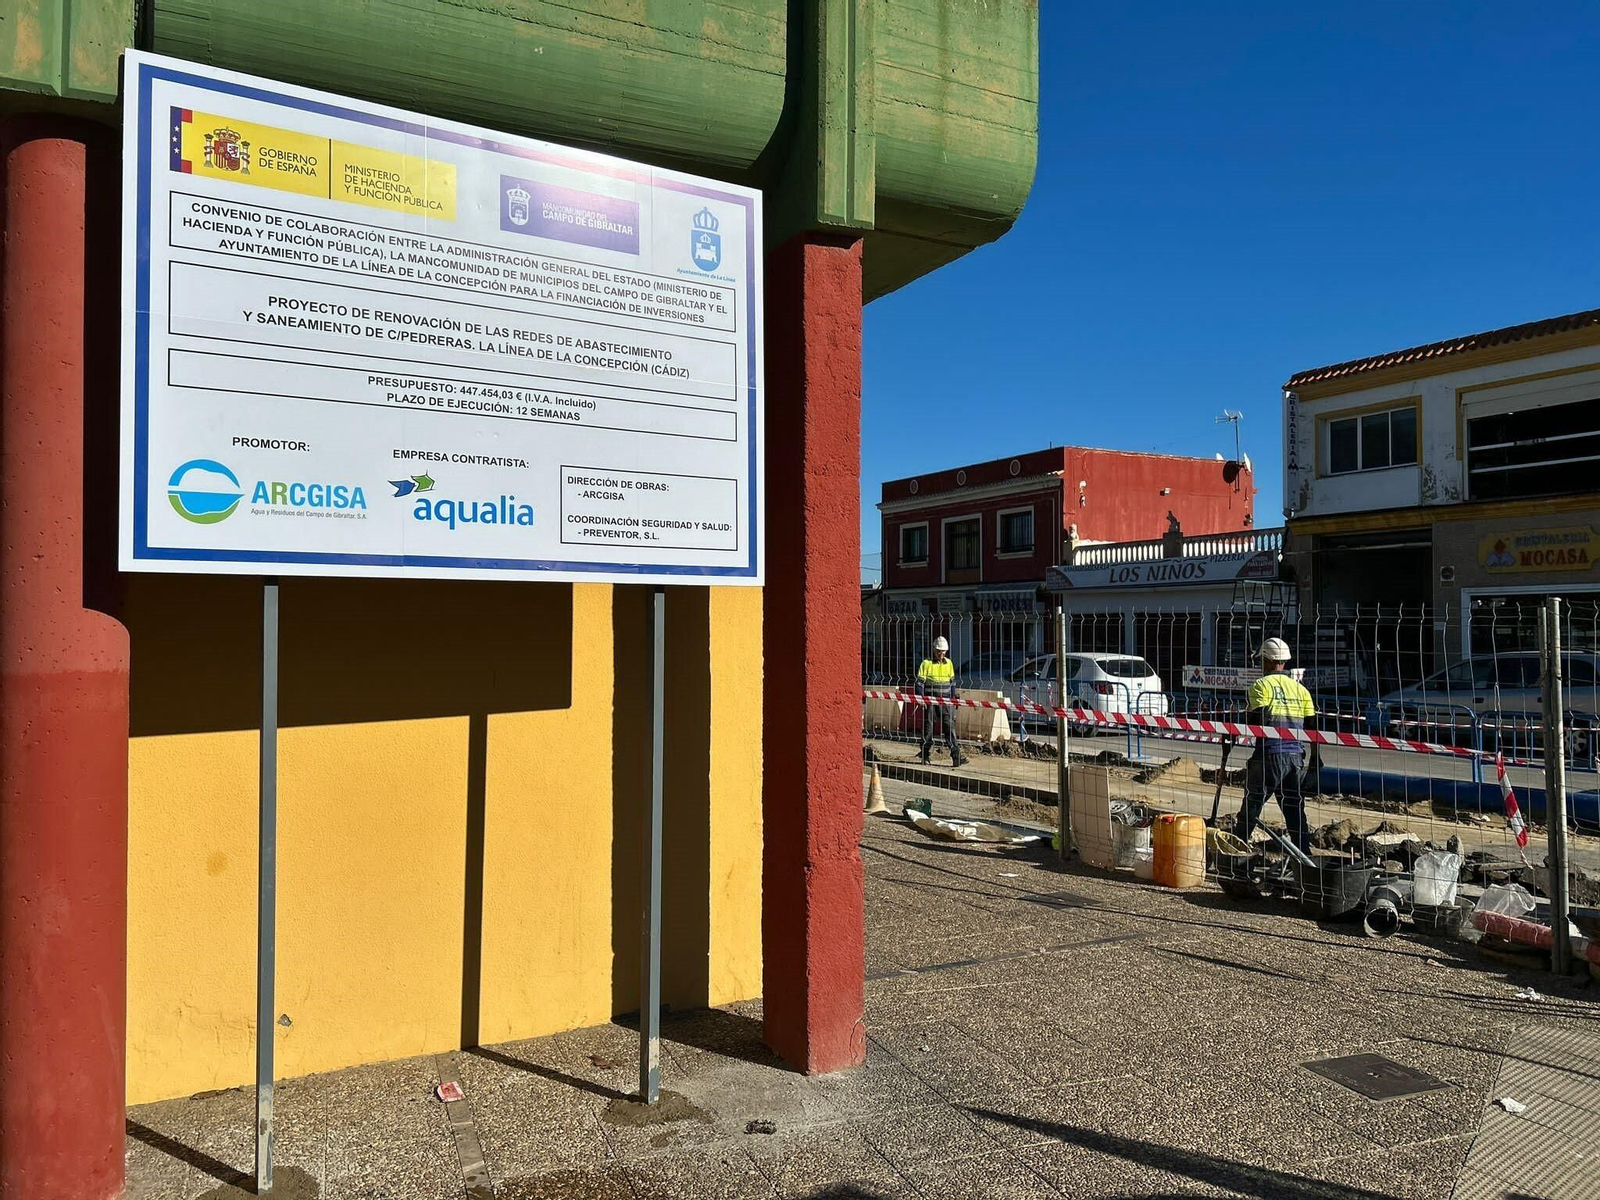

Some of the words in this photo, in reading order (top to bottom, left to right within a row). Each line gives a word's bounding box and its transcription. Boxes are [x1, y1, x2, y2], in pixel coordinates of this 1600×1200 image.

[258, 146, 317, 166] GOBIERNO
[258, 155, 274, 169] DE
[276, 158, 317, 177] ESPAÑA
[344, 163, 400, 182] MINISTERIO
[344, 173, 358, 185] DE
[360, 176, 412, 196] HACIENDA
[343, 182, 351, 194] Y
[354, 186, 401, 203] FUNCIÓN
[403, 193, 443, 211] PÚBLICA
[542, 202, 595, 219] MANCOMUNIDAD
[597, 212, 607, 221] DEL
[542, 210, 573, 224] CAMPO
[575, 216, 587, 227] DE
[588, 218, 633, 236] GIBRALTAR
[191, 202, 261, 222] CONVENIO
[265, 214, 282, 226] DE
[286, 218, 385, 243] COLABORACIÓN
[389, 235, 426, 250] ENTRE
[430, 242, 444, 253] LA
[446, 245, 538, 269] ADMINISTRACIÓN
[541, 261, 589, 278] GENERAL
[592, 270, 611, 281] DEL
[613, 274, 651, 288] ESTADO
[653, 281, 707, 298] (MINISTERIO
[709, 291, 721, 300] DE
[182, 216, 252, 237] HACIENDA
[255, 228, 264, 238] Y
[267, 230, 323, 248] FUNCIÓN
[327, 239, 386, 260] PÚBLICA),
[390, 250, 405, 261] LA
[408, 253, 499, 276] MANCOMUNIDAD
[502, 269, 517, 279] DE
[520, 272, 579, 289] MUNICIPIOS
[582, 282, 601, 293] DEL
[603, 286, 638, 299] CAMPO
[640, 292, 653, 301] DE
[655, 294, 706, 310] GIBRALTAR
[708, 303, 714, 311] Y
[716, 304, 727, 314] EL
[676, 268, 710, 278] Ayuntamiento
[218, 238, 318, 262] AYUNTAMIENTO
[322, 254, 339, 266] DE
[342, 257, 358, 269] LA
[361, 259, 396, 274] LÍNEA
[398, 266, 414, 278] DE
[416, 269, 432, 280] LA
[434, 272, 506, 292] CONCEPCIÓN
[509, 284, 538, 296] PARA
[540, 289, 554, 299] LA
[556, 291, 626, 311] FINANCIACIÓN
[628, 303, 641, 313] DE
[643, 305, 704, 323] INVERSIONES
[268, 295, 347, 316] PROYECTO
[351, 307, 370, 319] DE
[374, 310, 460, 331] RENOVACIÓN
[465, 322, 481, 334] DE
[485, 325, 509, 338] LAS
[513, 329, 553, 344] REDES
[556, 335, 572, 346] DE
[574, 338, 672, 360] ABASTECIMIENTO
[242, 310, 253, 322] Y
[256, 312, 361, 335] SANEAMIENTO
[365, 326, 383, 338] DE
[387, 329, 475, 350] C/PEDRERAS.
[479, 341, 495, 352] LA
[498, 341, 534, 357] LÍNEA
[537, 348, 553, 360] DE
[556, 351, 571, 363] LA
[574, 354, 647, 372] CONCEPCIÓN
[651, 363, 689, 379] (CÁDIZ)
[368, 375, 456, 393] PRESUPUESTO:
[459, 385, 513, 400] 447.454,03
[515, 391, 522, 400] €
[524, 392, 552, 404] (I.V.A.
[555, 396, 596, 411] Incluido)
[387, 392, 425, 404] PLAZO
[428, 396, 444, 406] DE
[447, 398, 512, 413] EJECUCIÓN:
[516, 405, 527, 415] 12
[530, 407, 580, 421] SEMANAS
[232, 436, 309, 451] PROMOTOR:
[393, 449, 449, 462] EMPRESA
[451, 453, 529, 468] CONTRATISTA:
[567, 475, 618, 487] DIRECCIÓN
[620, 480, 633, 489] DE
[635, 481, 669, 491] OBRAS:
[251, 480, 366, 509] ARCGISA
[582, 490, 624, 500] ARCGISA
[251, 508, 265, 516] Agua
[271, 509, 295, 517] Residuos
[306, 511, 324, 519] Campo
[413, 494, 534, 530] aqualia
[567, 514, 639, 526] COORDINACIÓN
[641, 518, 692, 529] SEGURIDAD
[701, 522, 731, 531] SALUD:
[583, 528, 641, 540] PREVENTOR,
[643, 531, 659, 540] S.L.
[1519, 548, 1589, 567] MOCASA
[1109, 565, 1140, 584] LOS
[1146, 559, 1208, 582] NIÑOS
